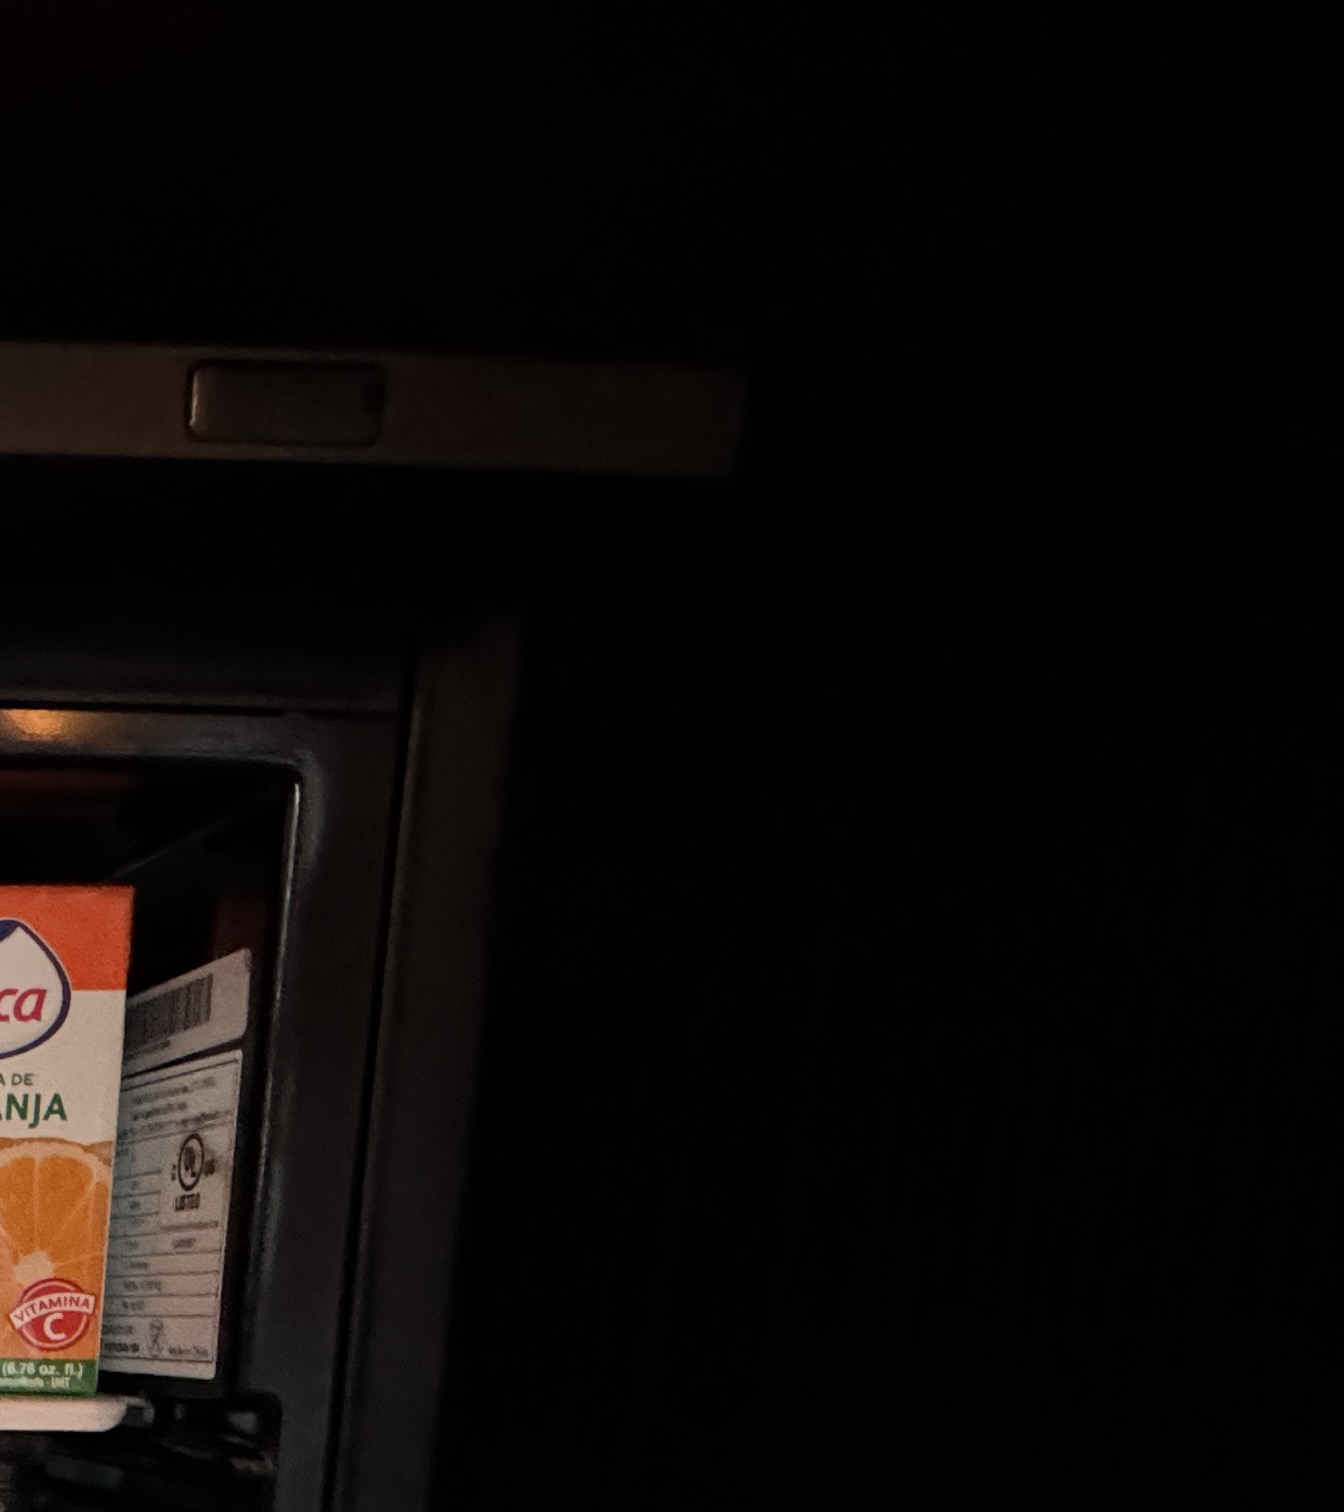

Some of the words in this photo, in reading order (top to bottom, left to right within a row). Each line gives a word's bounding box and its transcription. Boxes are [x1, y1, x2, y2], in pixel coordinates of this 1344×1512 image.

[11, 1073, 35, 1086] DE
[14, 1295, 91, 1322] VITAMINA
[43, 1312, 67, 1341] C
[39, 1366, 60, 1376] oz.
